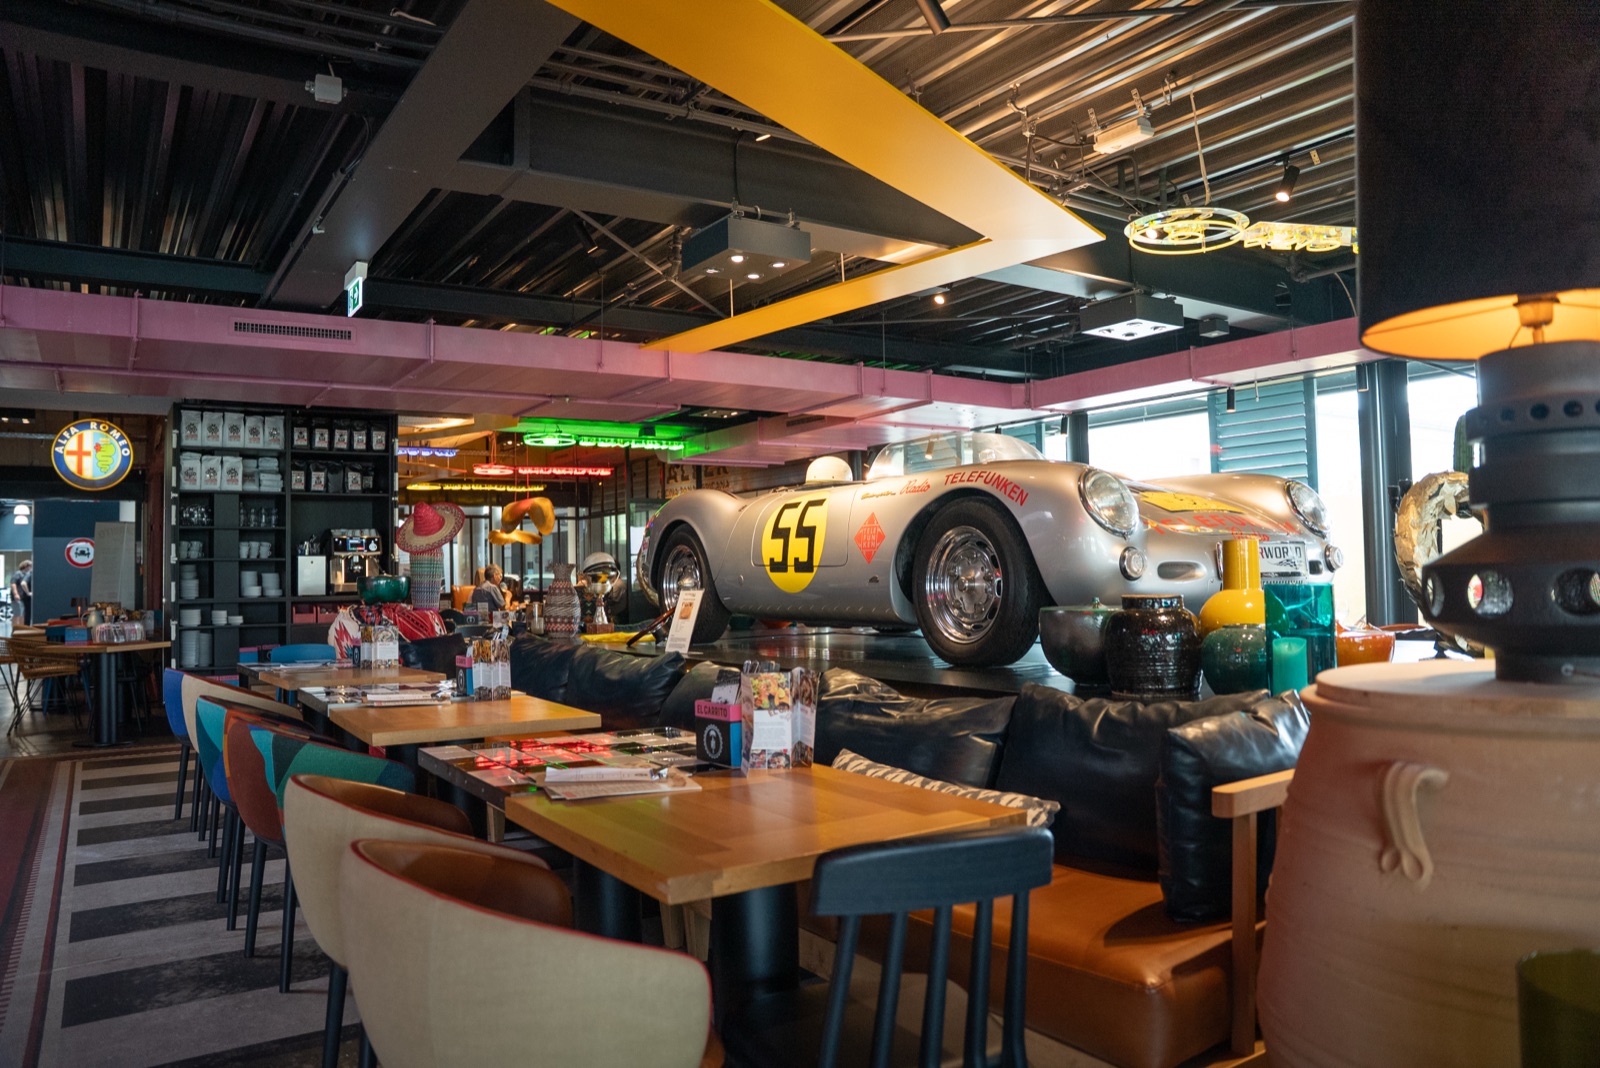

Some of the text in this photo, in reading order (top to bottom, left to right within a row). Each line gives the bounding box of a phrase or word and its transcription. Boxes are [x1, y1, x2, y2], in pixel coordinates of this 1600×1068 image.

[55, 421, 130, 457] ALFA ROMEO
[900, 479, 931, 495] Radio
[944, 470, 1029, 507] TELEFUNKEN
[769, 498, 827, 573] 55
[863, 541, 876, 549] KEN
[697, 705, 728, 718] EL CARRITO
